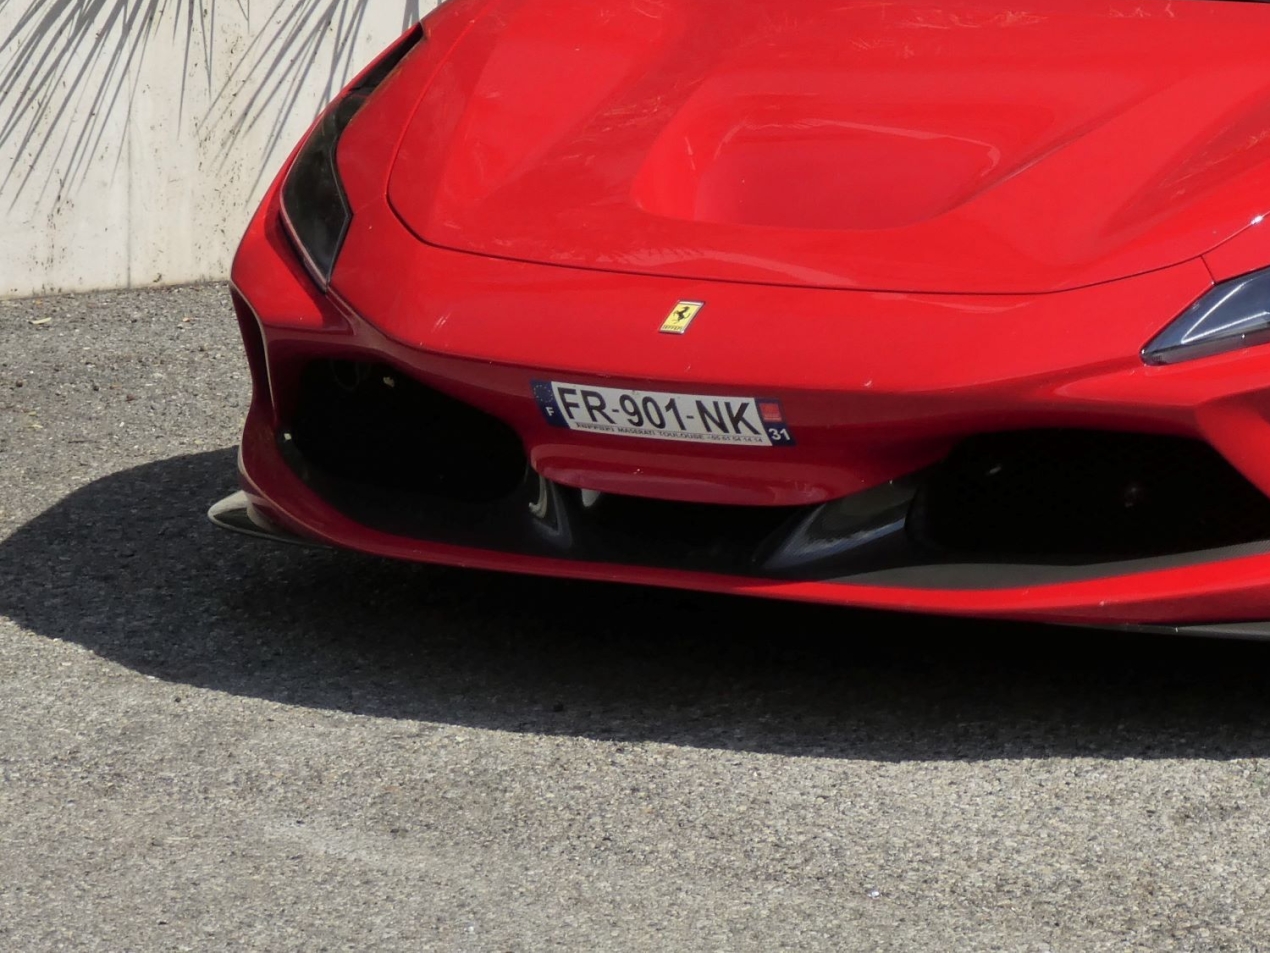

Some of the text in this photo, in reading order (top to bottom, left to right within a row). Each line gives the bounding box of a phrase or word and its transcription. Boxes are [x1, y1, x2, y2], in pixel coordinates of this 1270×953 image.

[546, 406, 555, 417] F
[557, 387, 762, 435] FR-901-NK
[769, 427, 791, 441] 31
